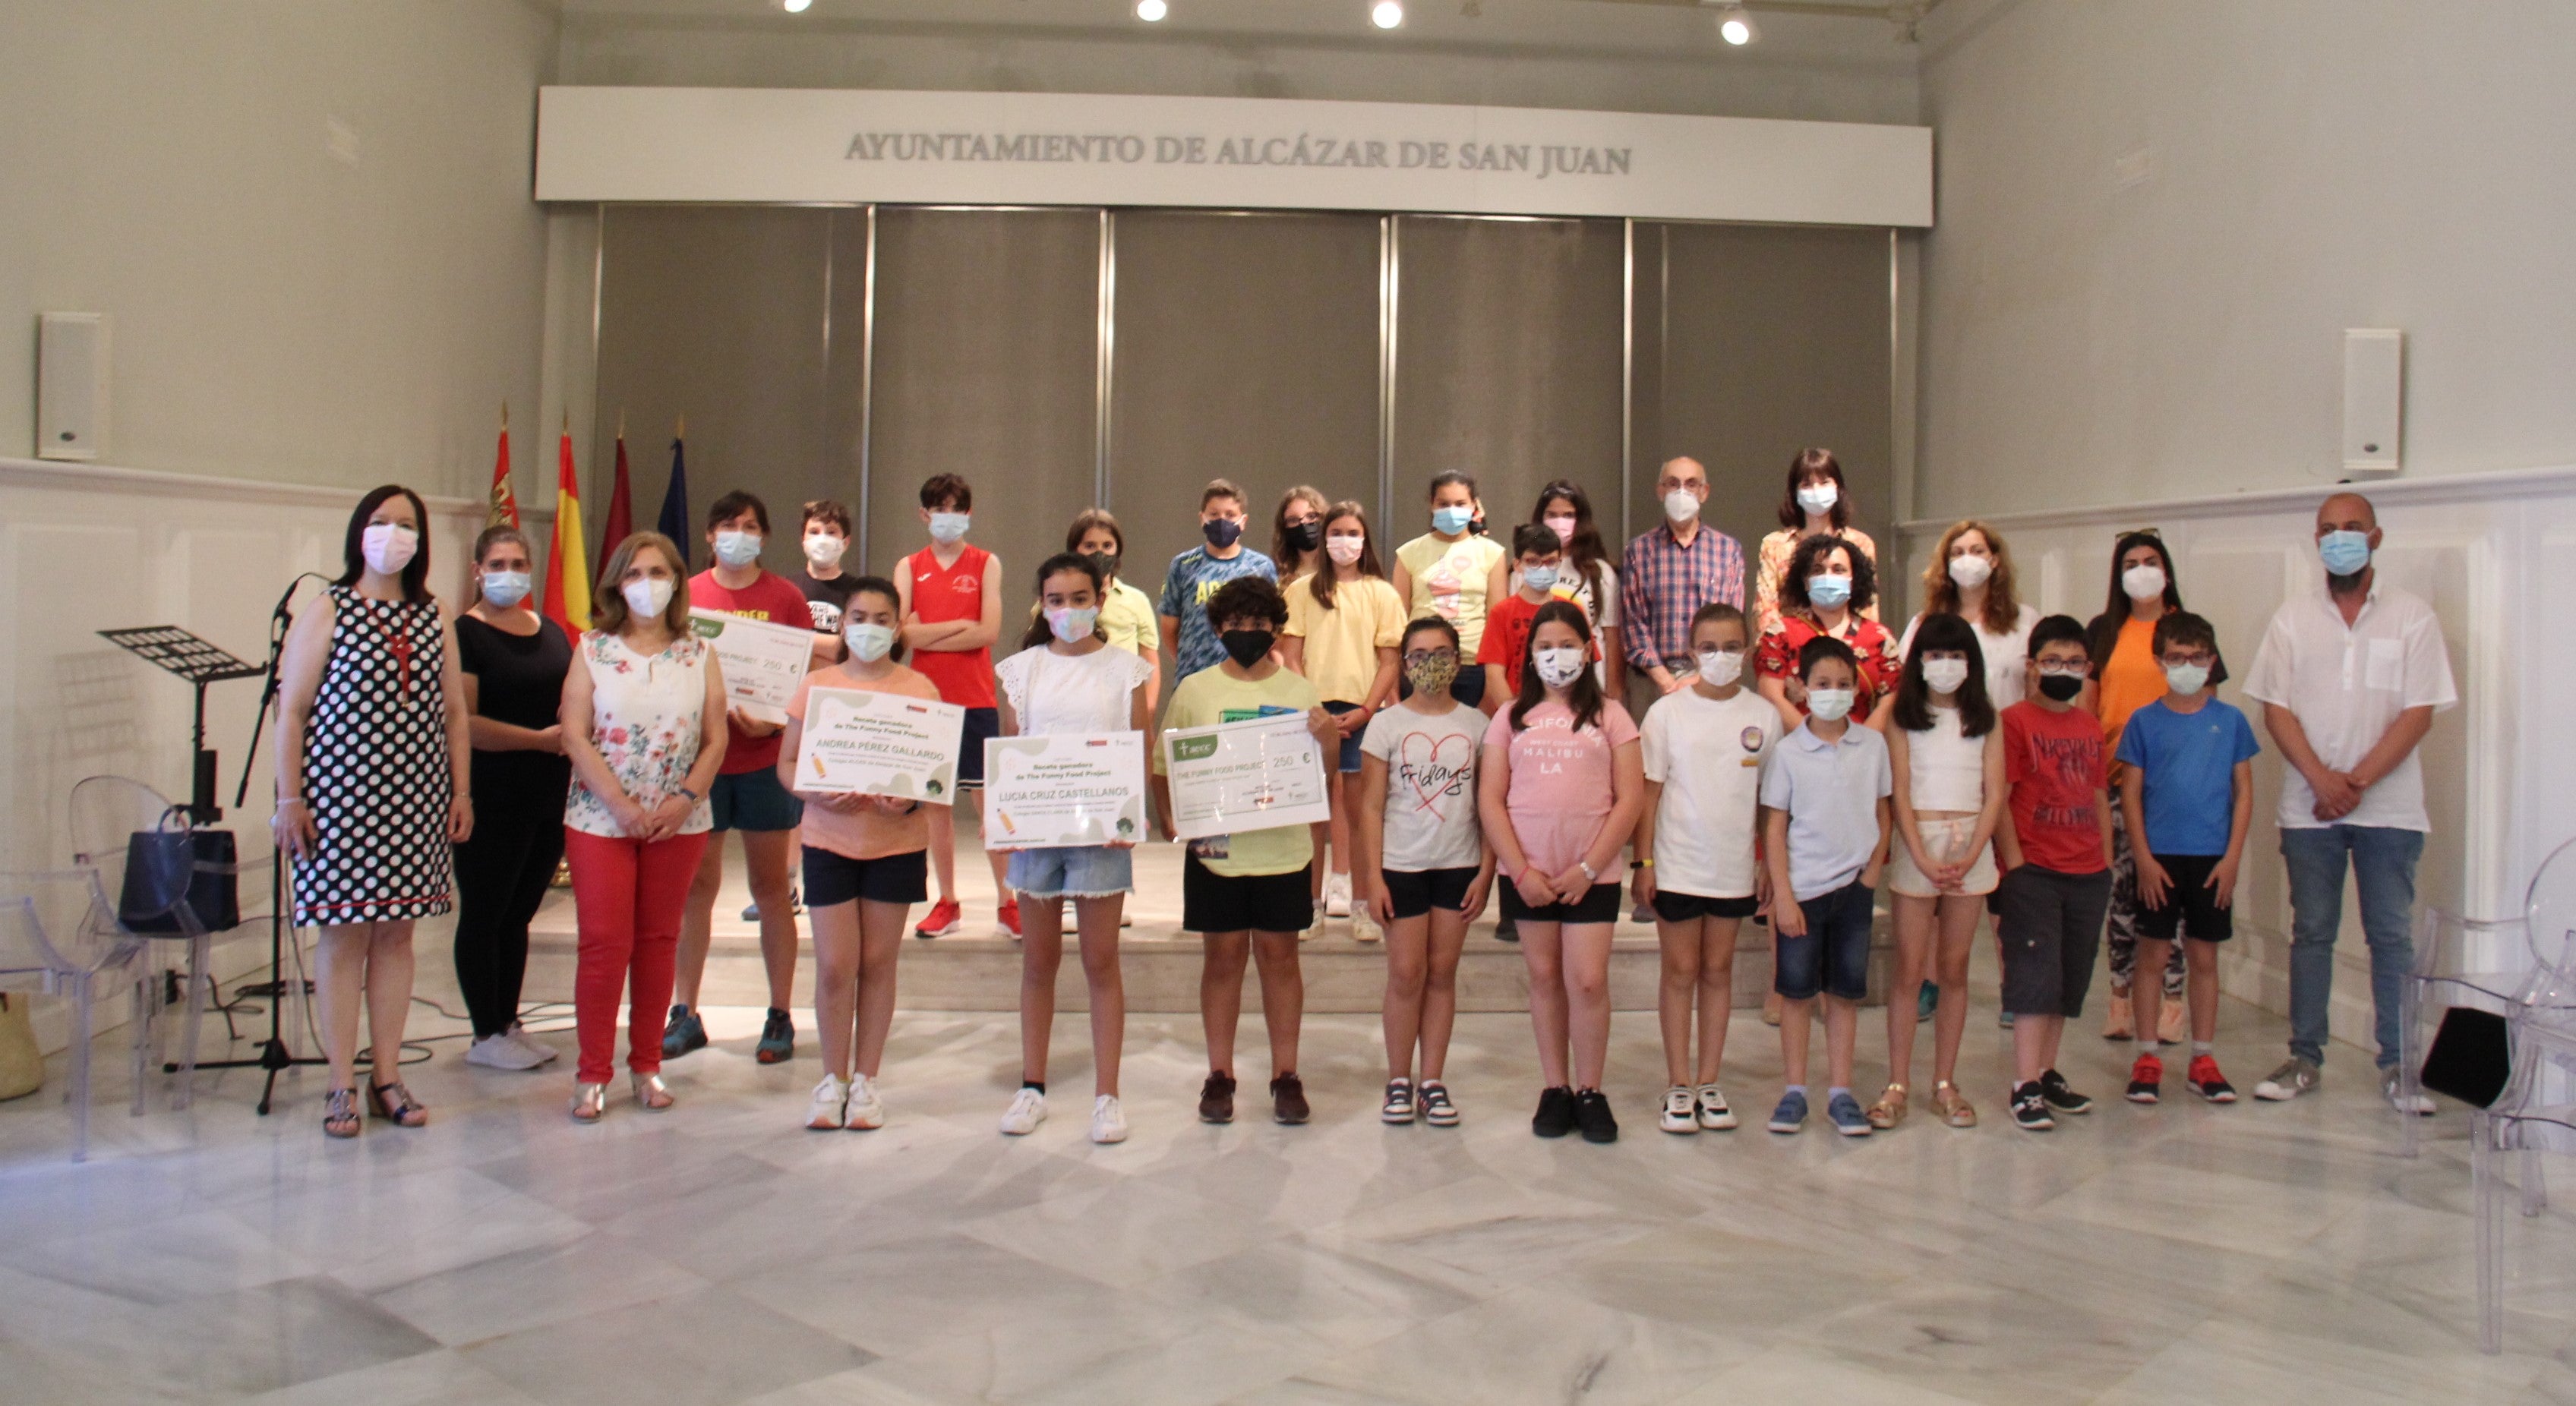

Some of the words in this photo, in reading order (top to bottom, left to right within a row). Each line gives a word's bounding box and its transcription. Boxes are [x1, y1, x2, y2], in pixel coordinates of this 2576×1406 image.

[844, 134, 1145, 162] AYUNTAMIENTO
[1154, 137, 1206, 163] DE
[1217, 132, 1389, 167] ALCÁZAR
[1397, 141, 1449, 169] DE
[1457, 143, 1529, 172] SAN
[1536, 146, 1633, 179] JUAN
[816, 739, 856, 749] ANDREA
[892, 745, 944, 761] GALLARDO
[1523, 748, 1583, 758] MALIBU
[1274, 755, 1293, 768] 250
[1540, 762, 1563, 774] LA
[1030, 790, 1056, 800] CRUZ
[1058, 787, 1129, 799] CASTELLANOS
